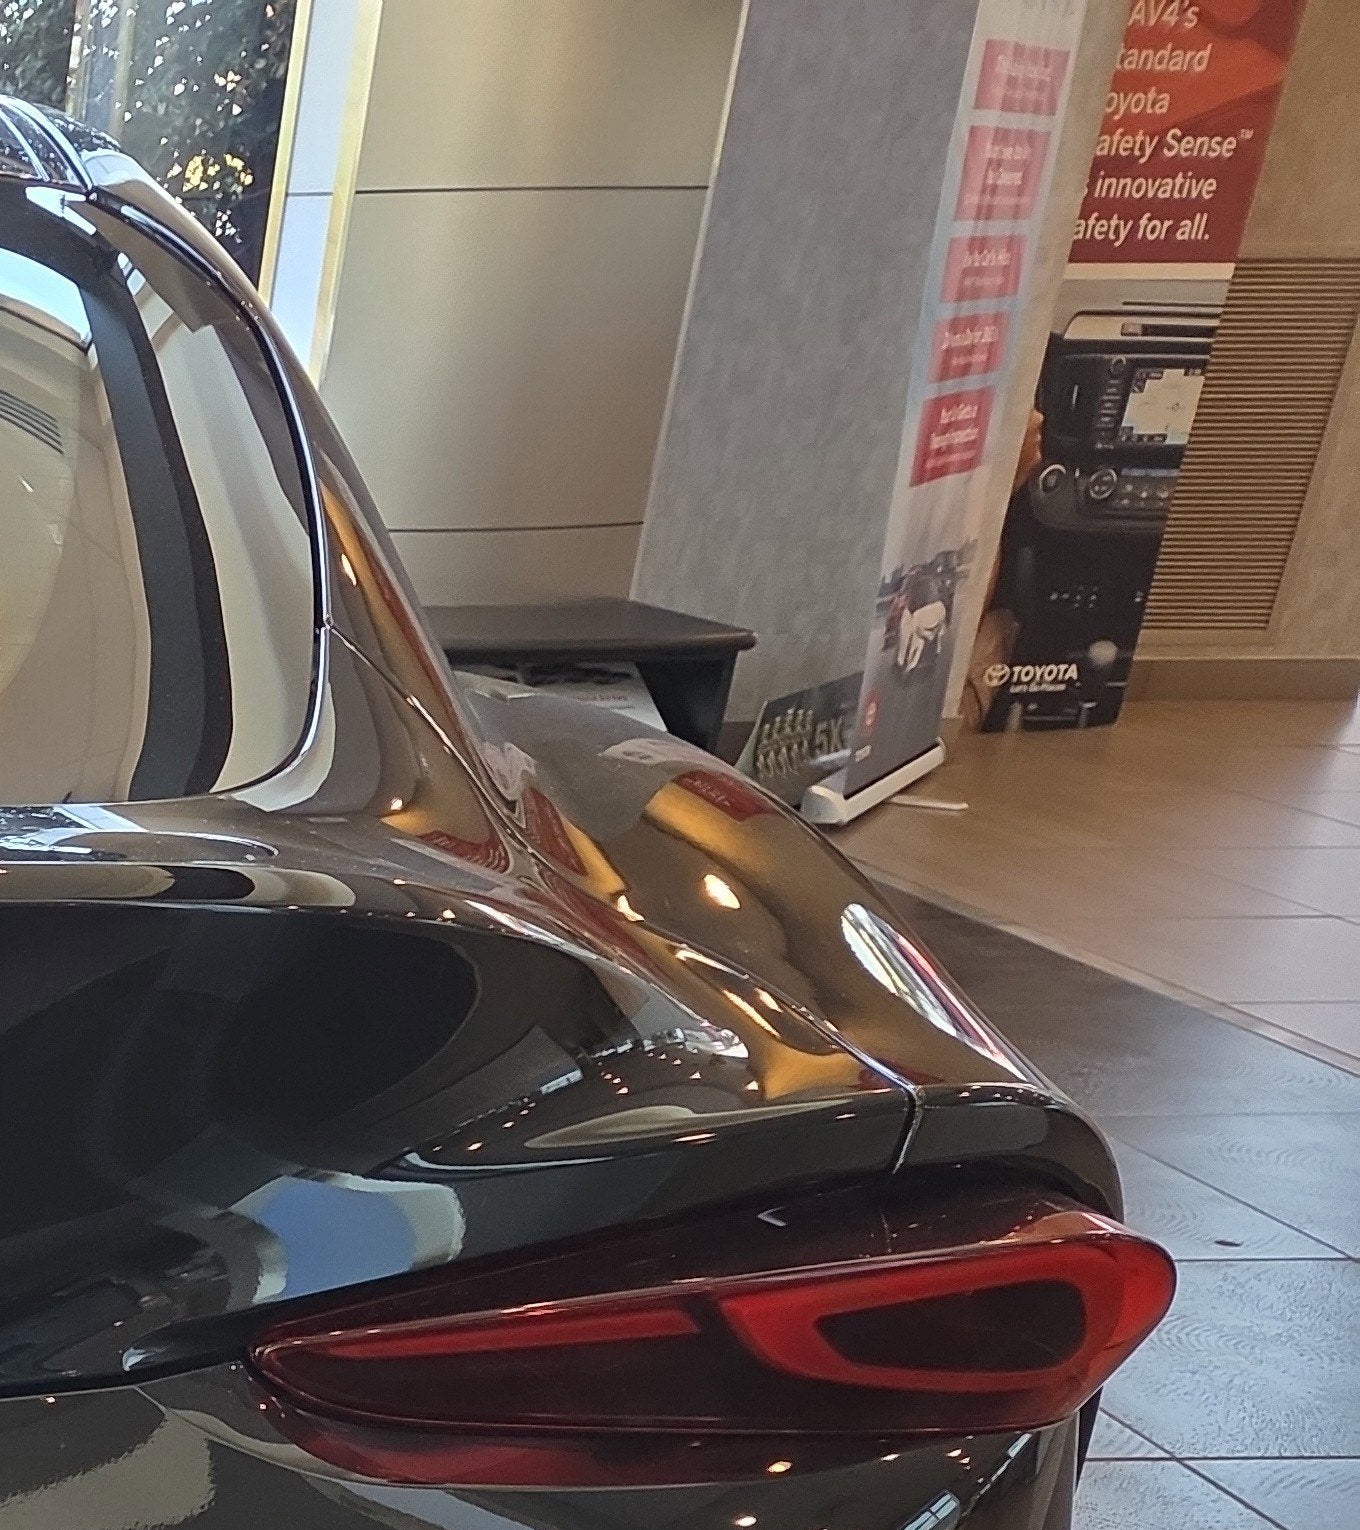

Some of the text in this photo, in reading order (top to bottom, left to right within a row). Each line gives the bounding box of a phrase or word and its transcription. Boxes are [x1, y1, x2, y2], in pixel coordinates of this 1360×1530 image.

[1129, 0, 1199, 28] AV4's
[1115, 42, 1213, 72] tandard
[1105, 87, 1170, 120] oyota
[1096, 128, 1159, 164] afety
[1094, 170, 1217, 200] innovative
[1073, 212, 1210, 247] afety for all.
[1011, 664, 1078, 683] TOYOTA
